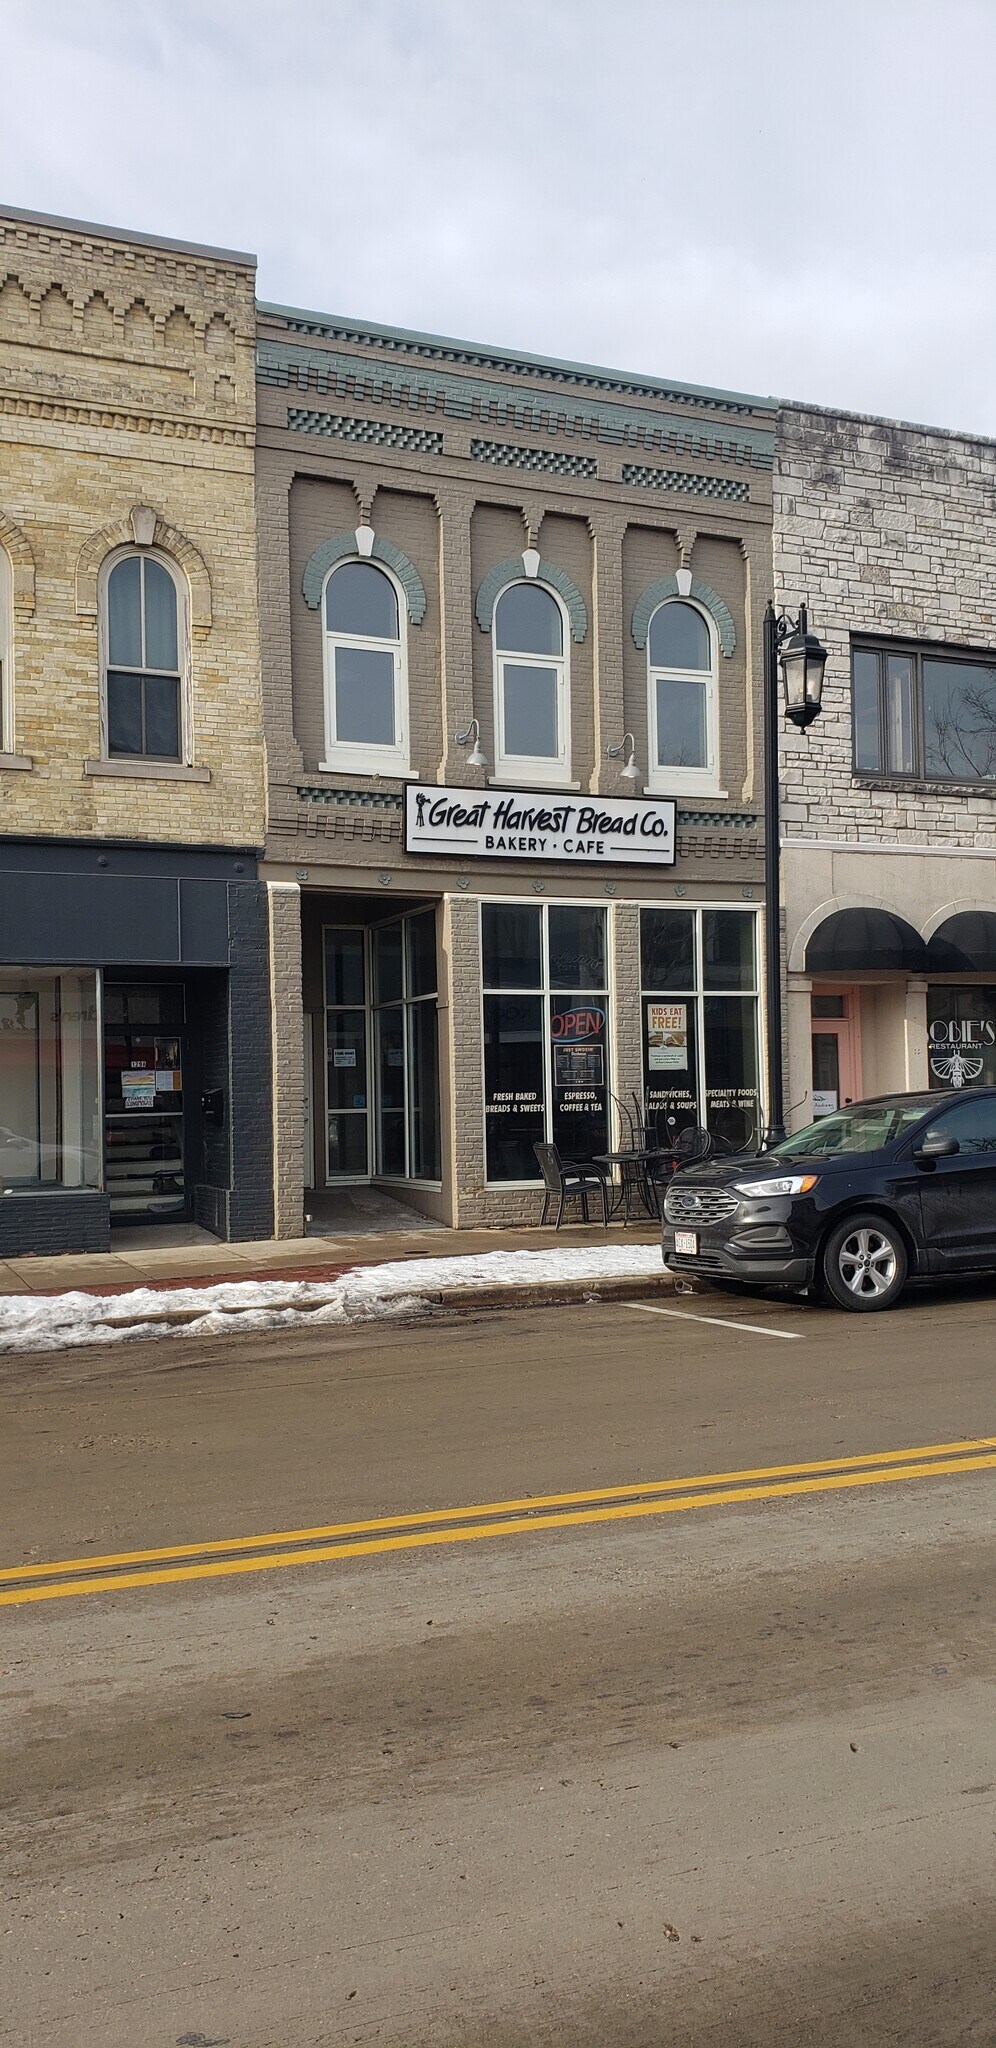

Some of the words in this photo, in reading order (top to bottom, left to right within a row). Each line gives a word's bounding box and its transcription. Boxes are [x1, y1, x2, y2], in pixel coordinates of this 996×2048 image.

[428, 797, 491, 828] Great
[492, 798, 576, 834] Harvest
[576, 807, 639, 836] Bread
[639, 811, 669, 838] Co.
[485, 835, 547, 852] BAKERY
[563, 839, 605, 854] CAFE
[651, 1007, 668, 1016] KIDS
[669, 1007, 683, 1016] EAT
[551, 1012, 601, 1038] OPEN
[652, 1016, 682, 1029] FREE!
[929, 1020, 995, 1046] OBIE'S
[493, 1092, 513, 1101] FRESH
[515, 1092, 537, 1101] BAKED
[564, 1091, 598, 1101] ESPRESSO,
[649, 1089, 692, 1099] SANDWICHES,
[485, 1103, 511, 1113] BREADS
[512, 1103, 518, 1112] &
[519, 1103, 545, 1112] SWEETS
[559, 1103, 584, 1112] COFFEE
[584, 1103, 589, 1112] &
[589, 1103, 603, 1112] TEA
[669, 1101, 675, 1110] &
[676, 1101, 697, 1110] SOUPS
[710, 1099, 730, 1108] MEATS
[737, 1099, 754, 1108] WINE
